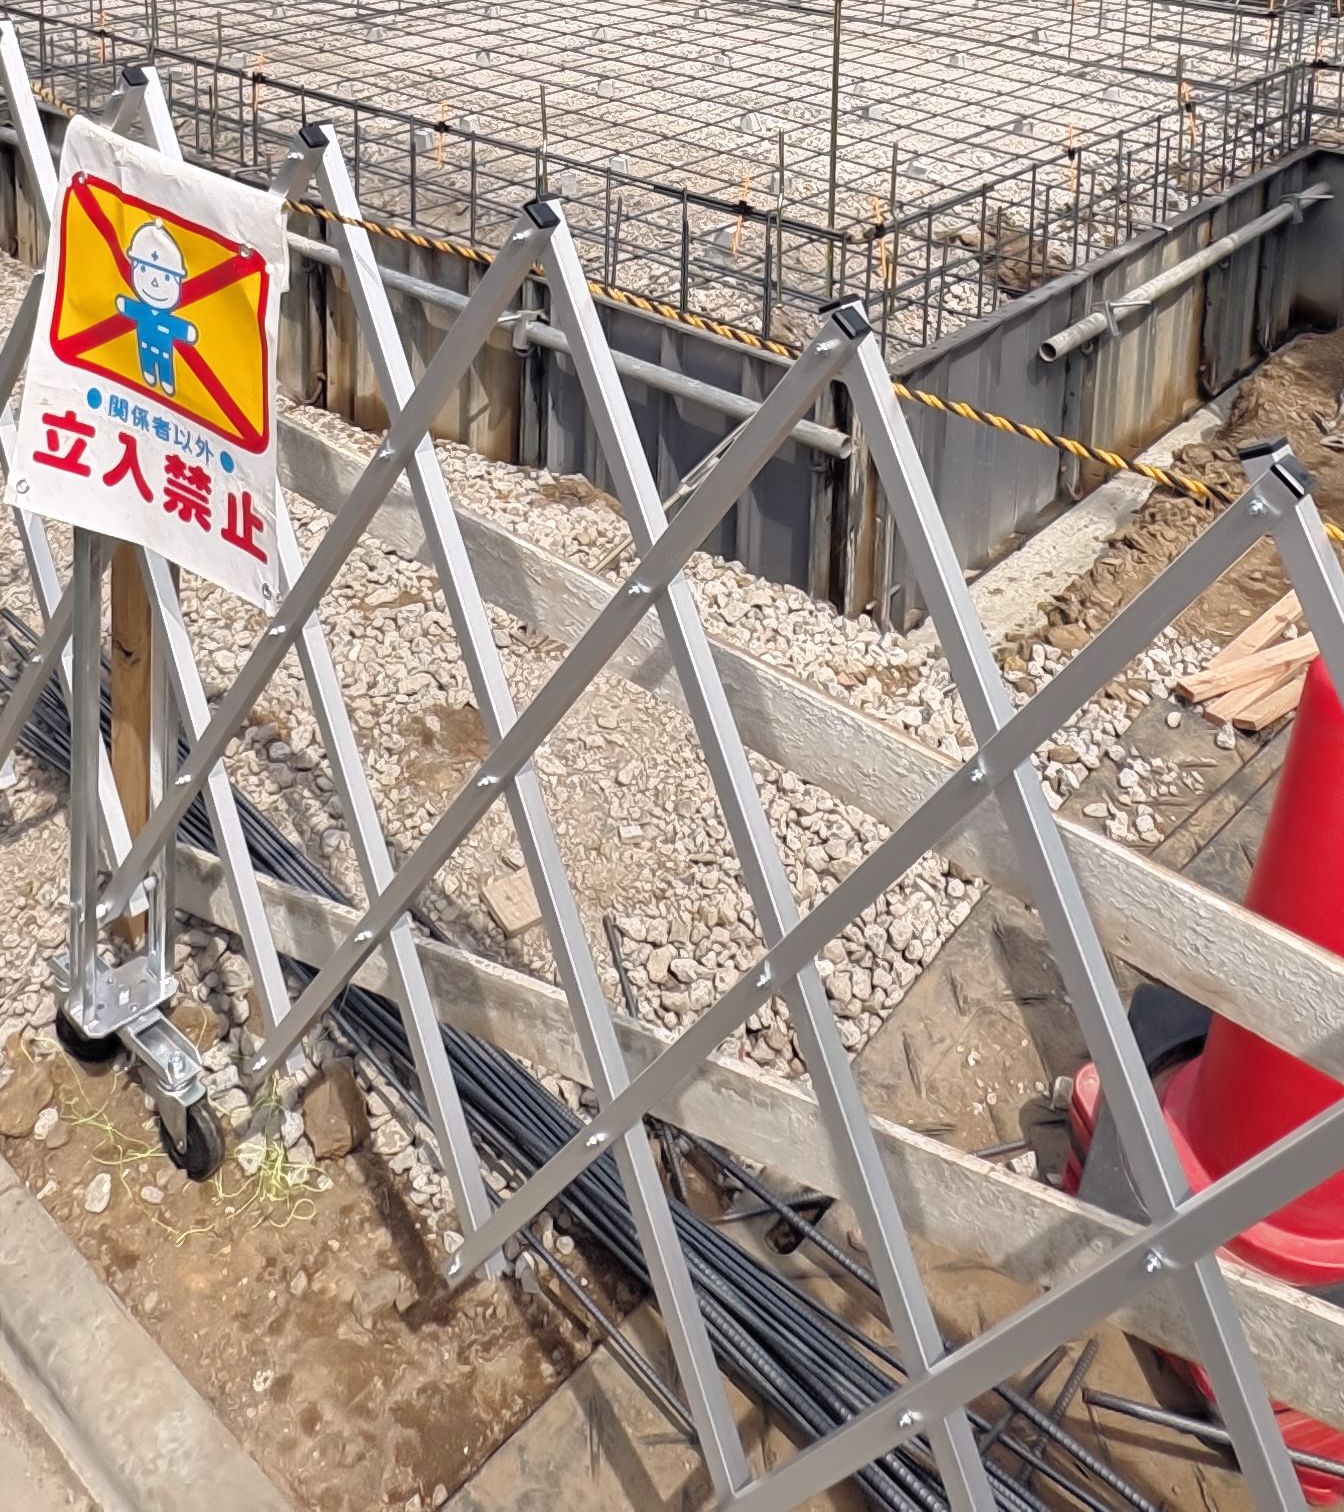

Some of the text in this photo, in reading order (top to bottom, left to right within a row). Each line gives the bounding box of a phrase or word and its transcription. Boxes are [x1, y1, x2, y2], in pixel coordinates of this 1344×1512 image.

[107, 394, 214, 464] 関係者以外
[32, 410, 268, 565] 立入禁止
